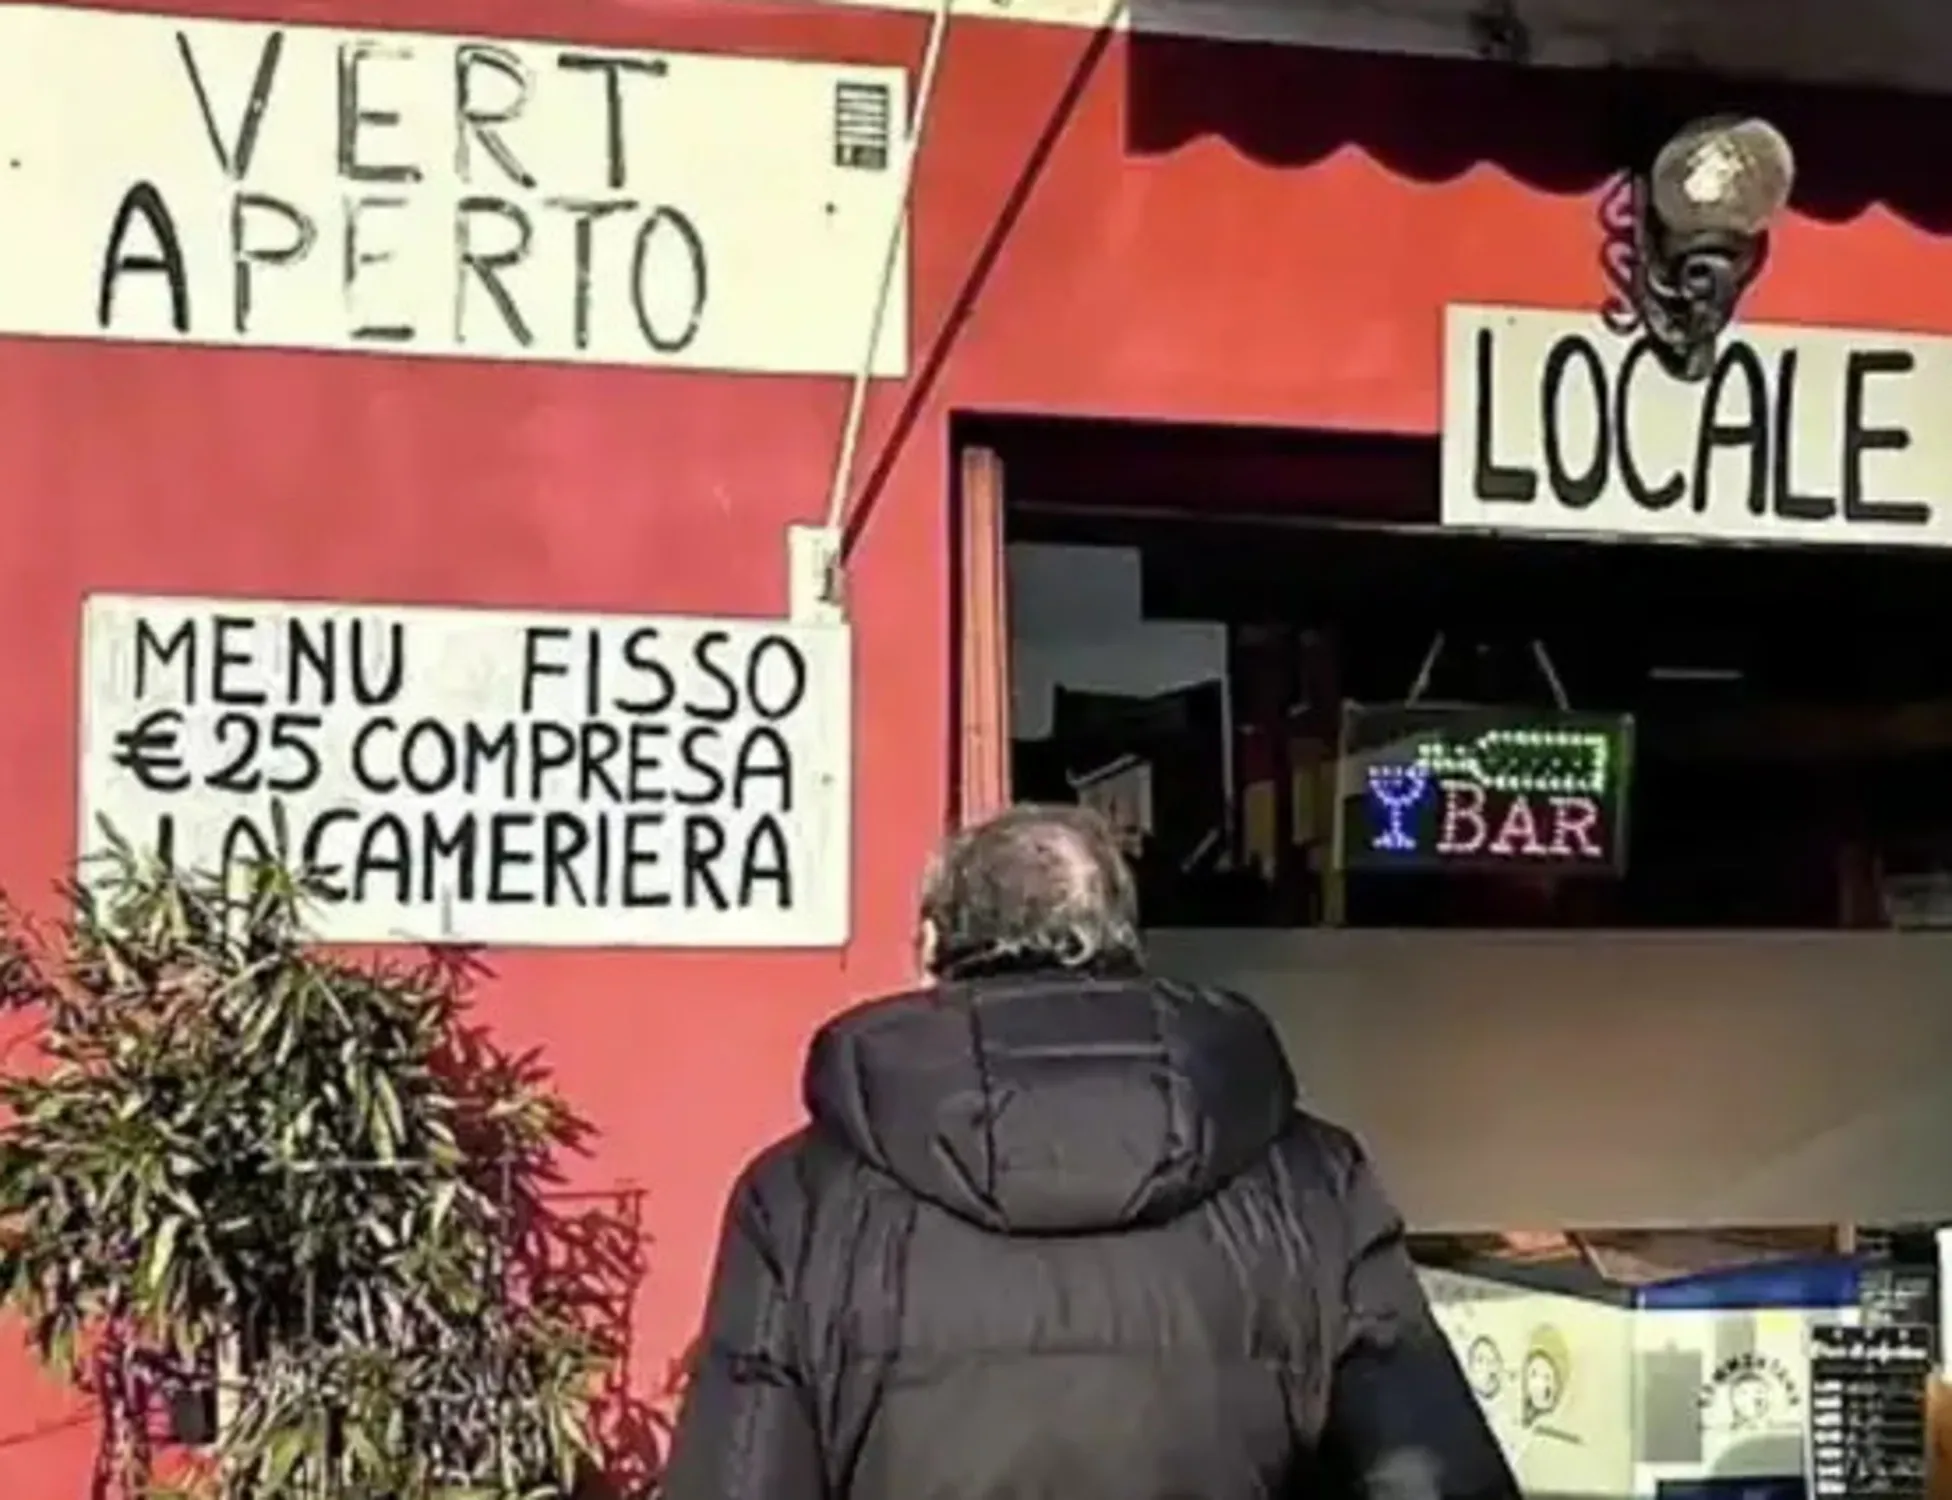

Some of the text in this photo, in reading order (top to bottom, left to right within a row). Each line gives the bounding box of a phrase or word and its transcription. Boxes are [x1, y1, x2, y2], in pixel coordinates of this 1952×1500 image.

[174, 31, 669, 190] VERT
[98, 179, 708, 353] APERTO
[1473, 327, 1931, 524] LOCALE
[134, 616, 807, 722] MENU FISSO
[351, 718, 793, 811] COMPRESA
[1436, 778, 1603, 857] BAR
[302, 807, 793, 910] CAMERIERA
